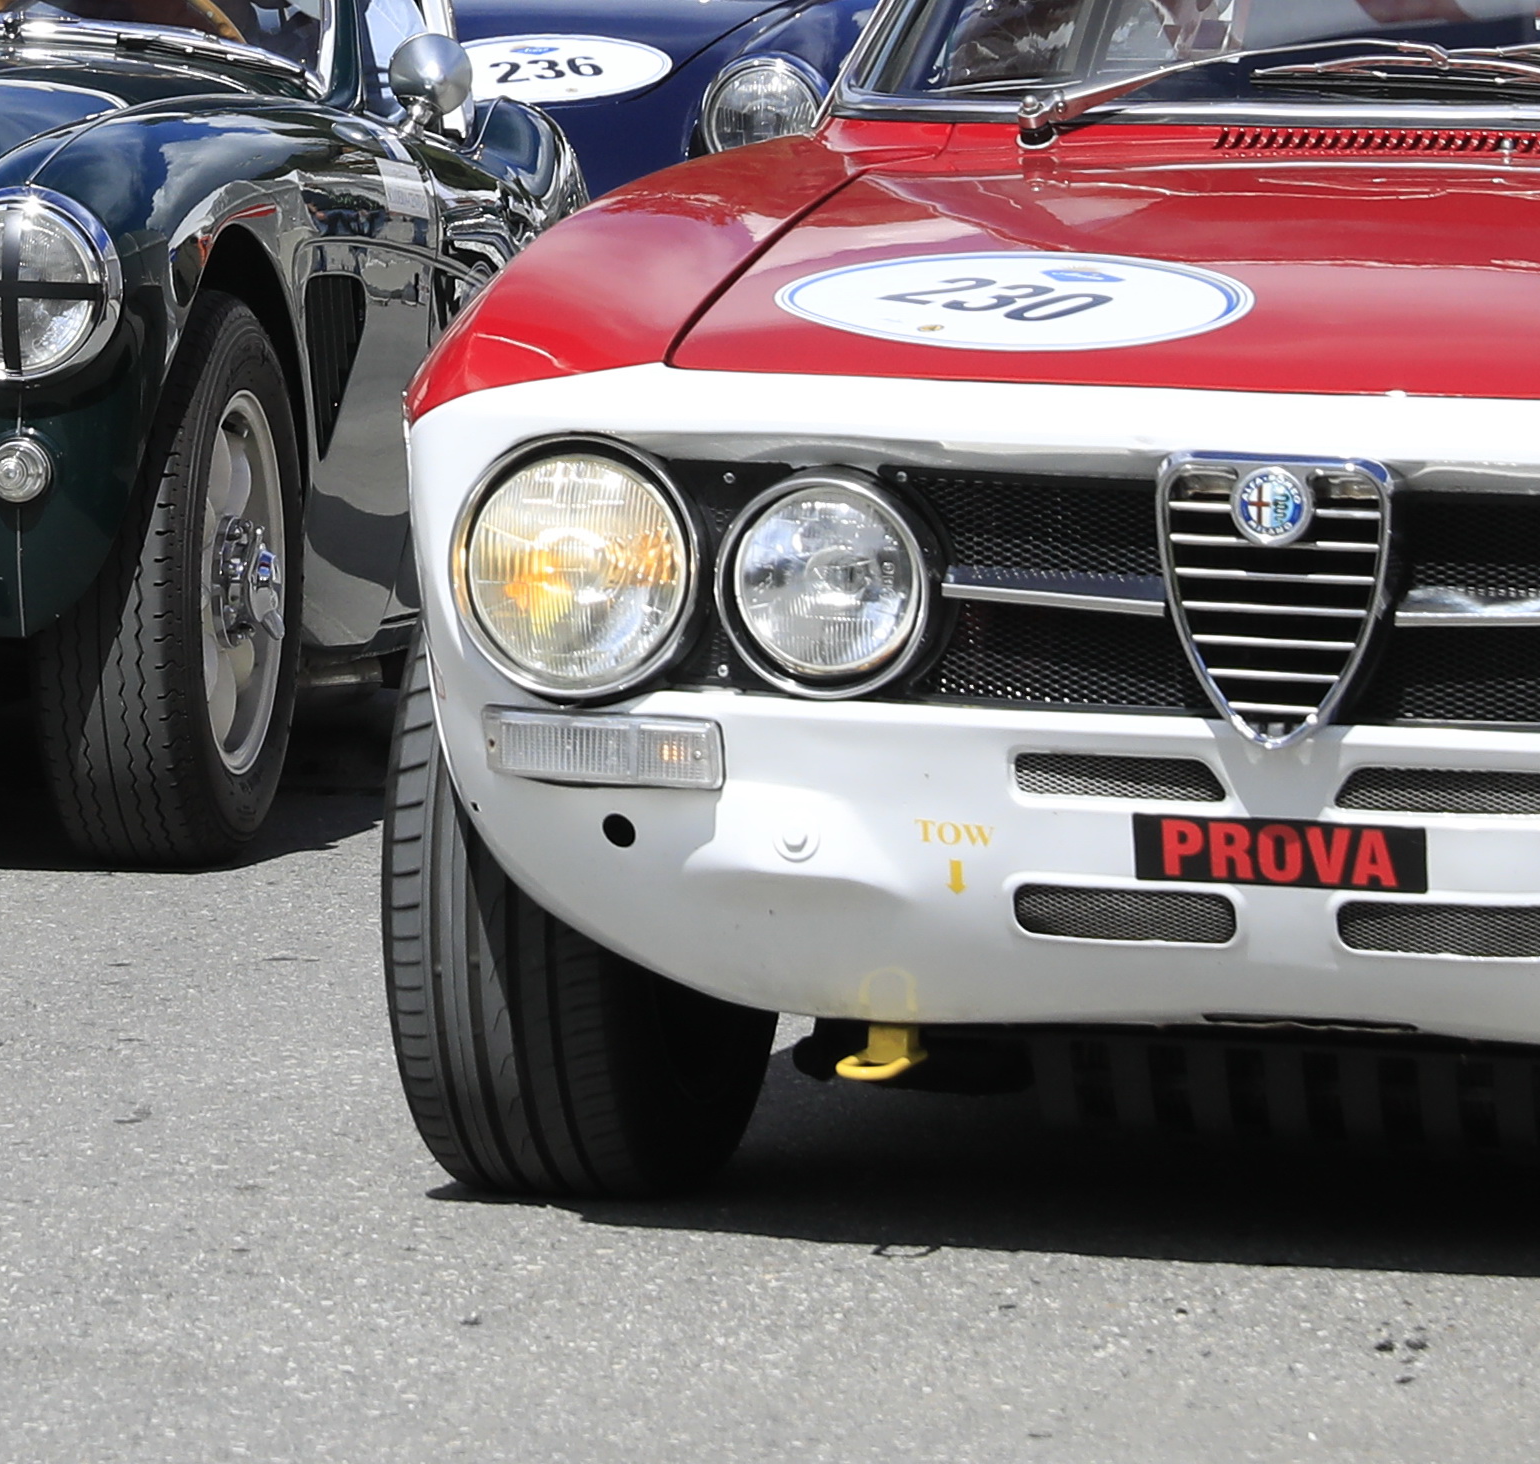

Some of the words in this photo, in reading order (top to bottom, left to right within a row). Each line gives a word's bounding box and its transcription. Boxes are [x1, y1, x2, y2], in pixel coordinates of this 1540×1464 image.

[489, 56, 603, 84] 236
[877, 277, 1113, 321] 230
[913, 817, 995, 847] TOW
[1161, 818, 1400, 887] PROVA
